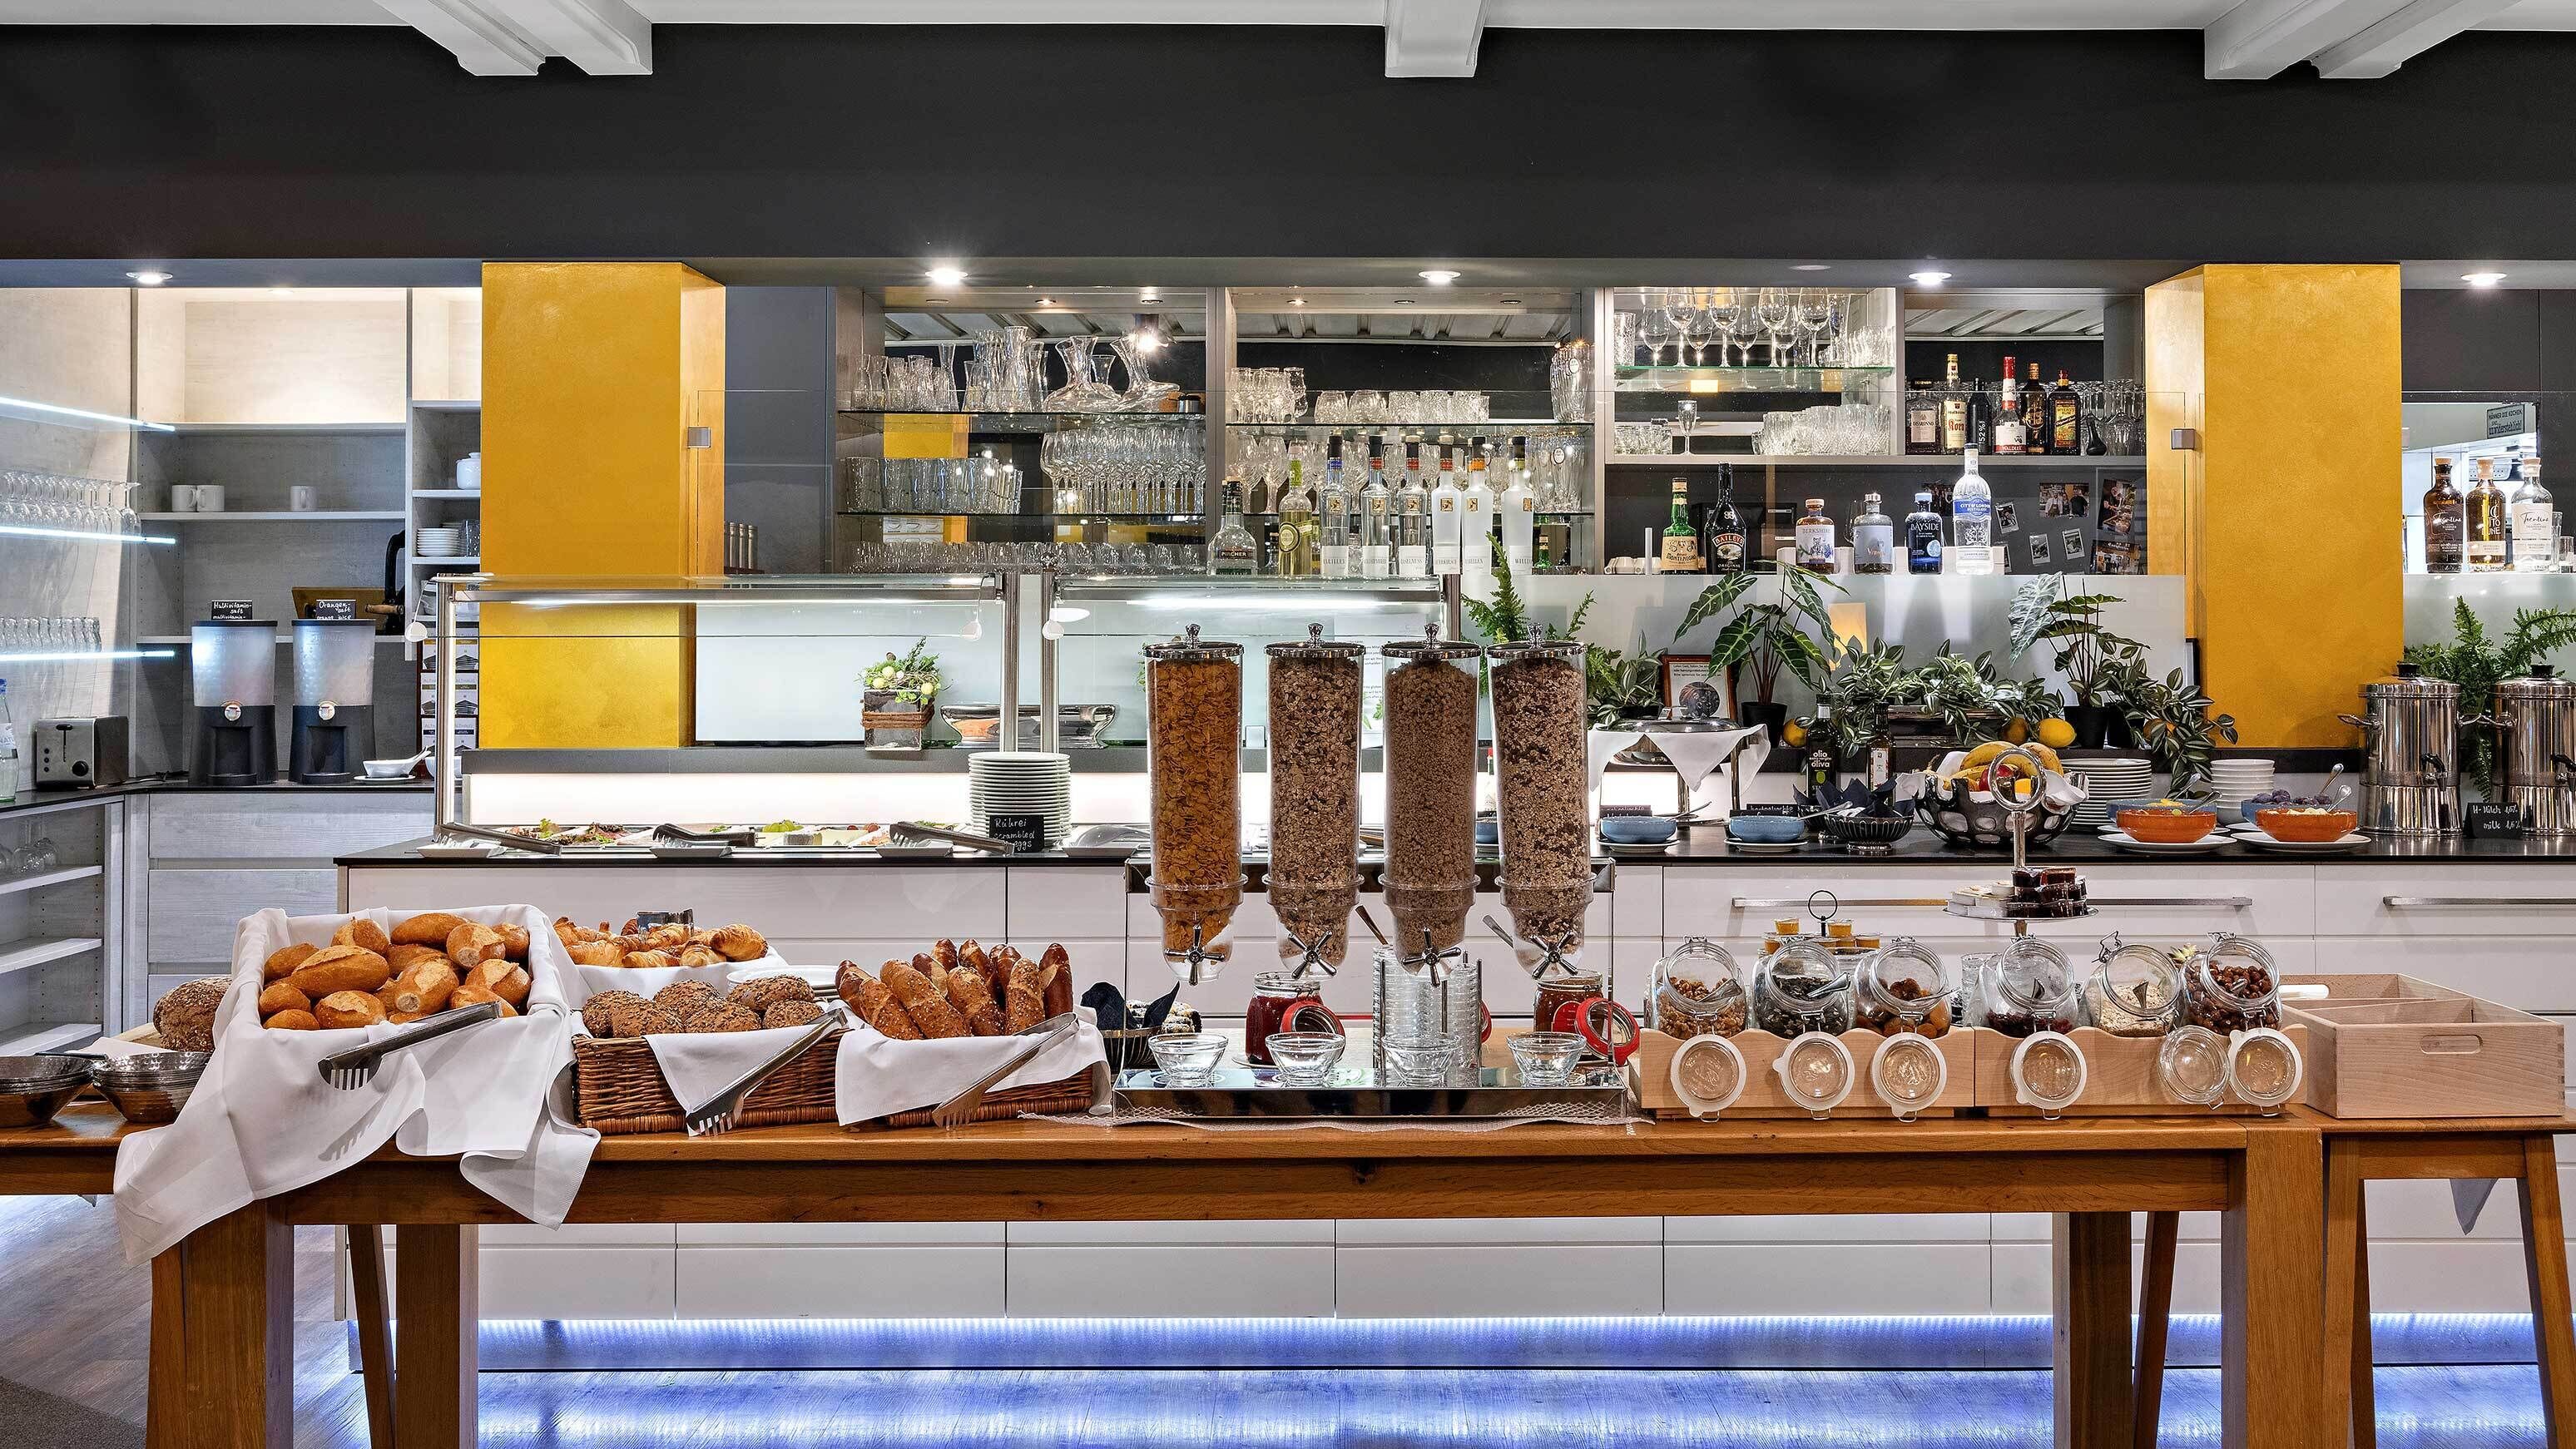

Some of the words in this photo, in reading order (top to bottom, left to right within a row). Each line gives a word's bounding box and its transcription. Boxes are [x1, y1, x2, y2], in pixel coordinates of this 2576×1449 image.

[1910, 522, 1939, 532] BAYSIDE
[1715, 535, 1744, 545] BAILEYS
[1812, 749, 1828, 758] olio
[1811, 759, 1830, 768] oliva
[993, 818, 1027, 828] Rührei
[2483, 820, 2501, 830] milk
[993, 830, 1035, 840] scrambled
[1014, 840, 1033, 852] eggs
